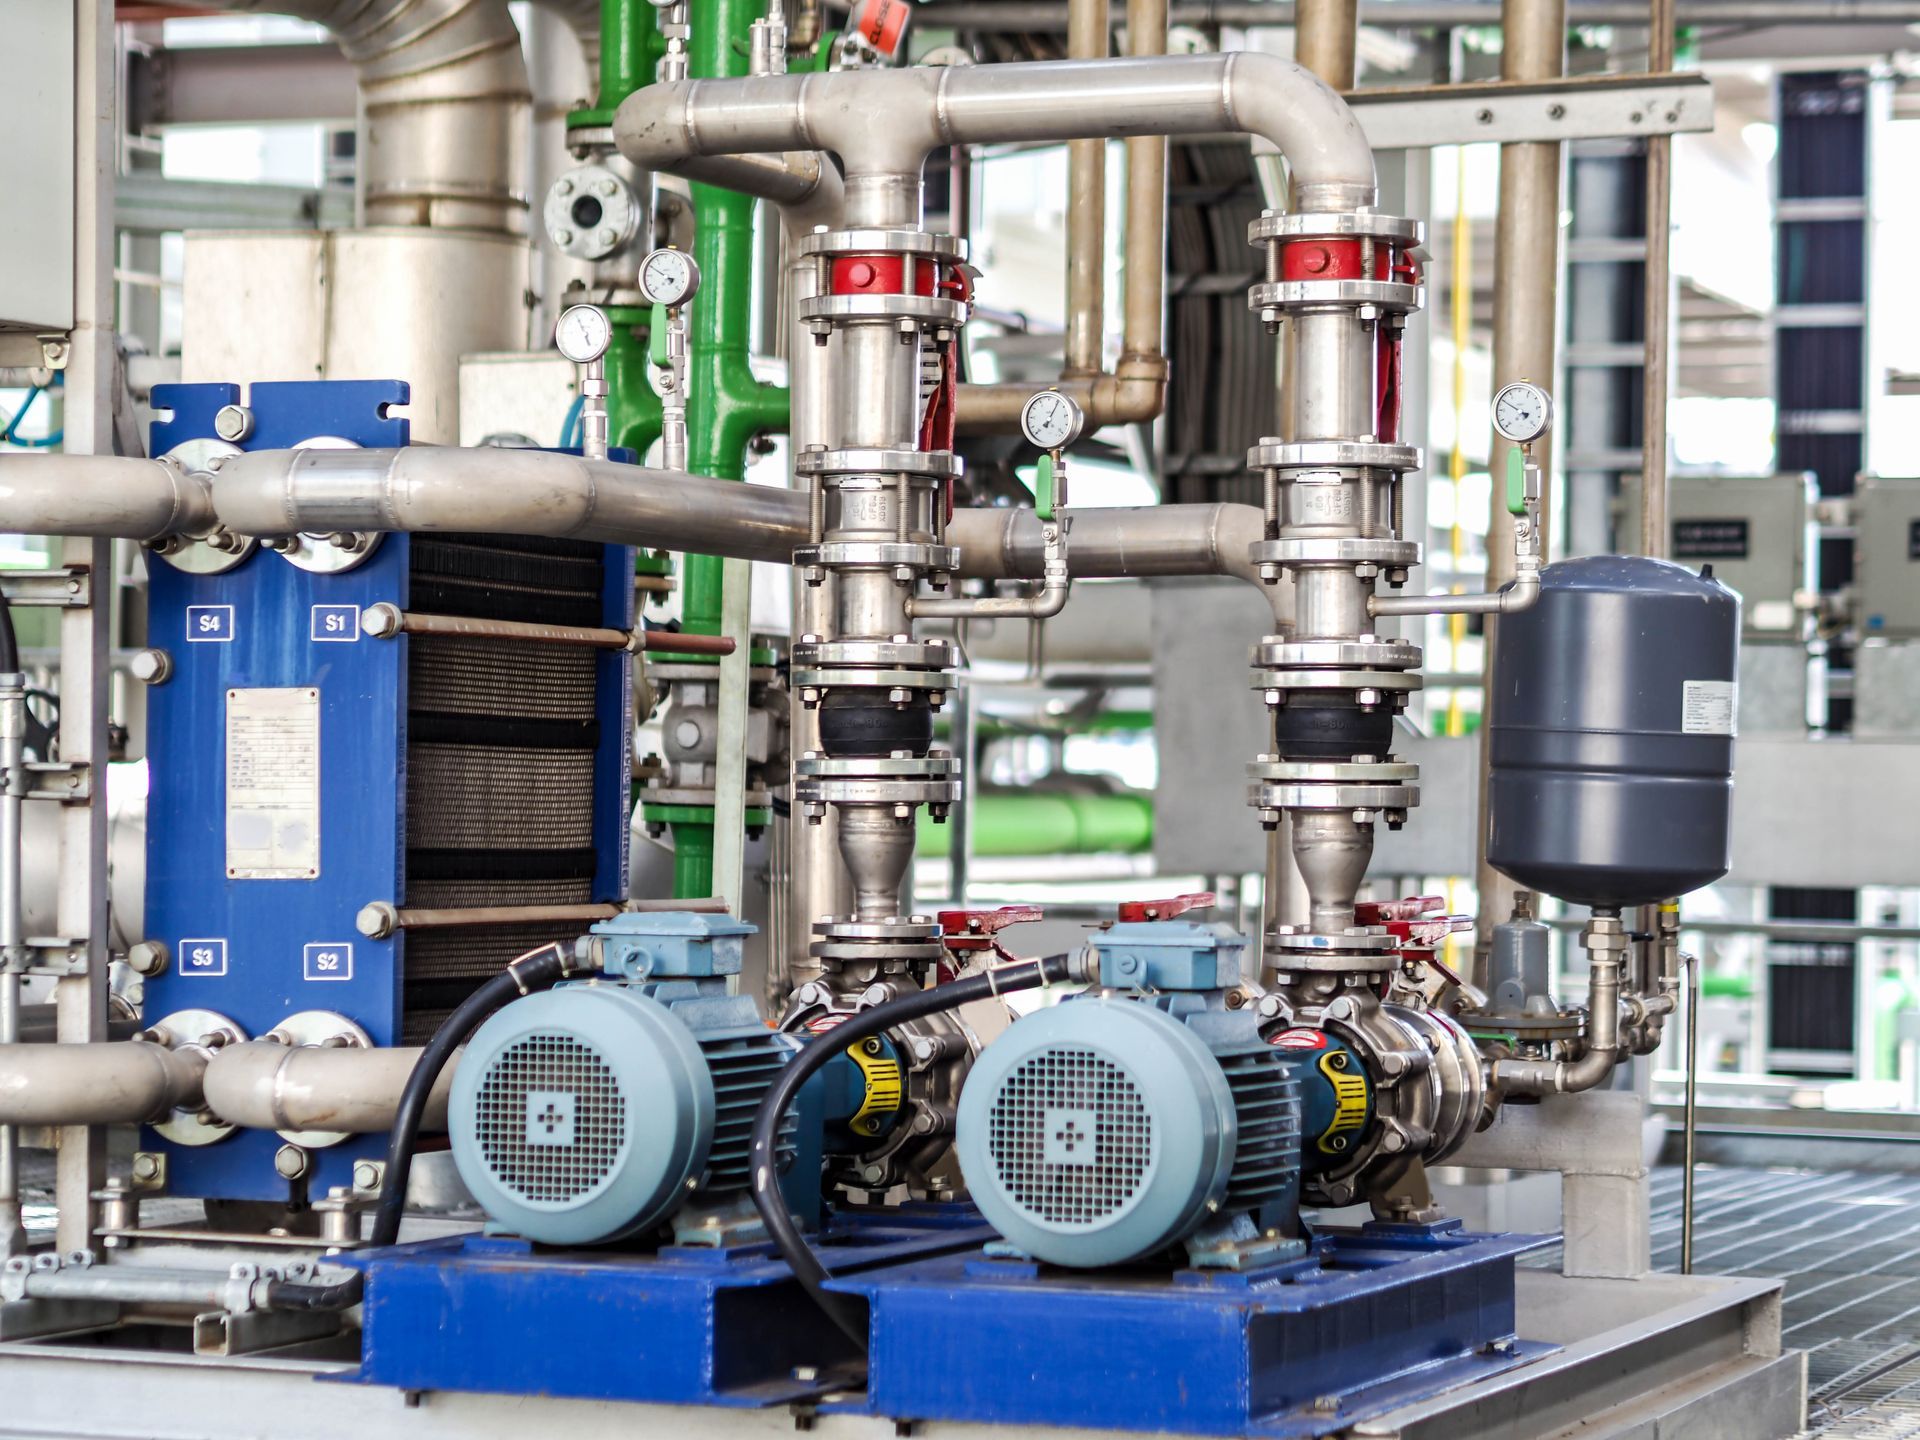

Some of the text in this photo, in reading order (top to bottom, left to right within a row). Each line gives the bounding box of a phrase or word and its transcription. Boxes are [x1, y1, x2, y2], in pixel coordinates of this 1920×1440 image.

[199, 615, 221, 632] S4
[325, 614, 346, 632] S1
[192, 948, 214, 966] S3
[317, 953, 339, 970] S2
